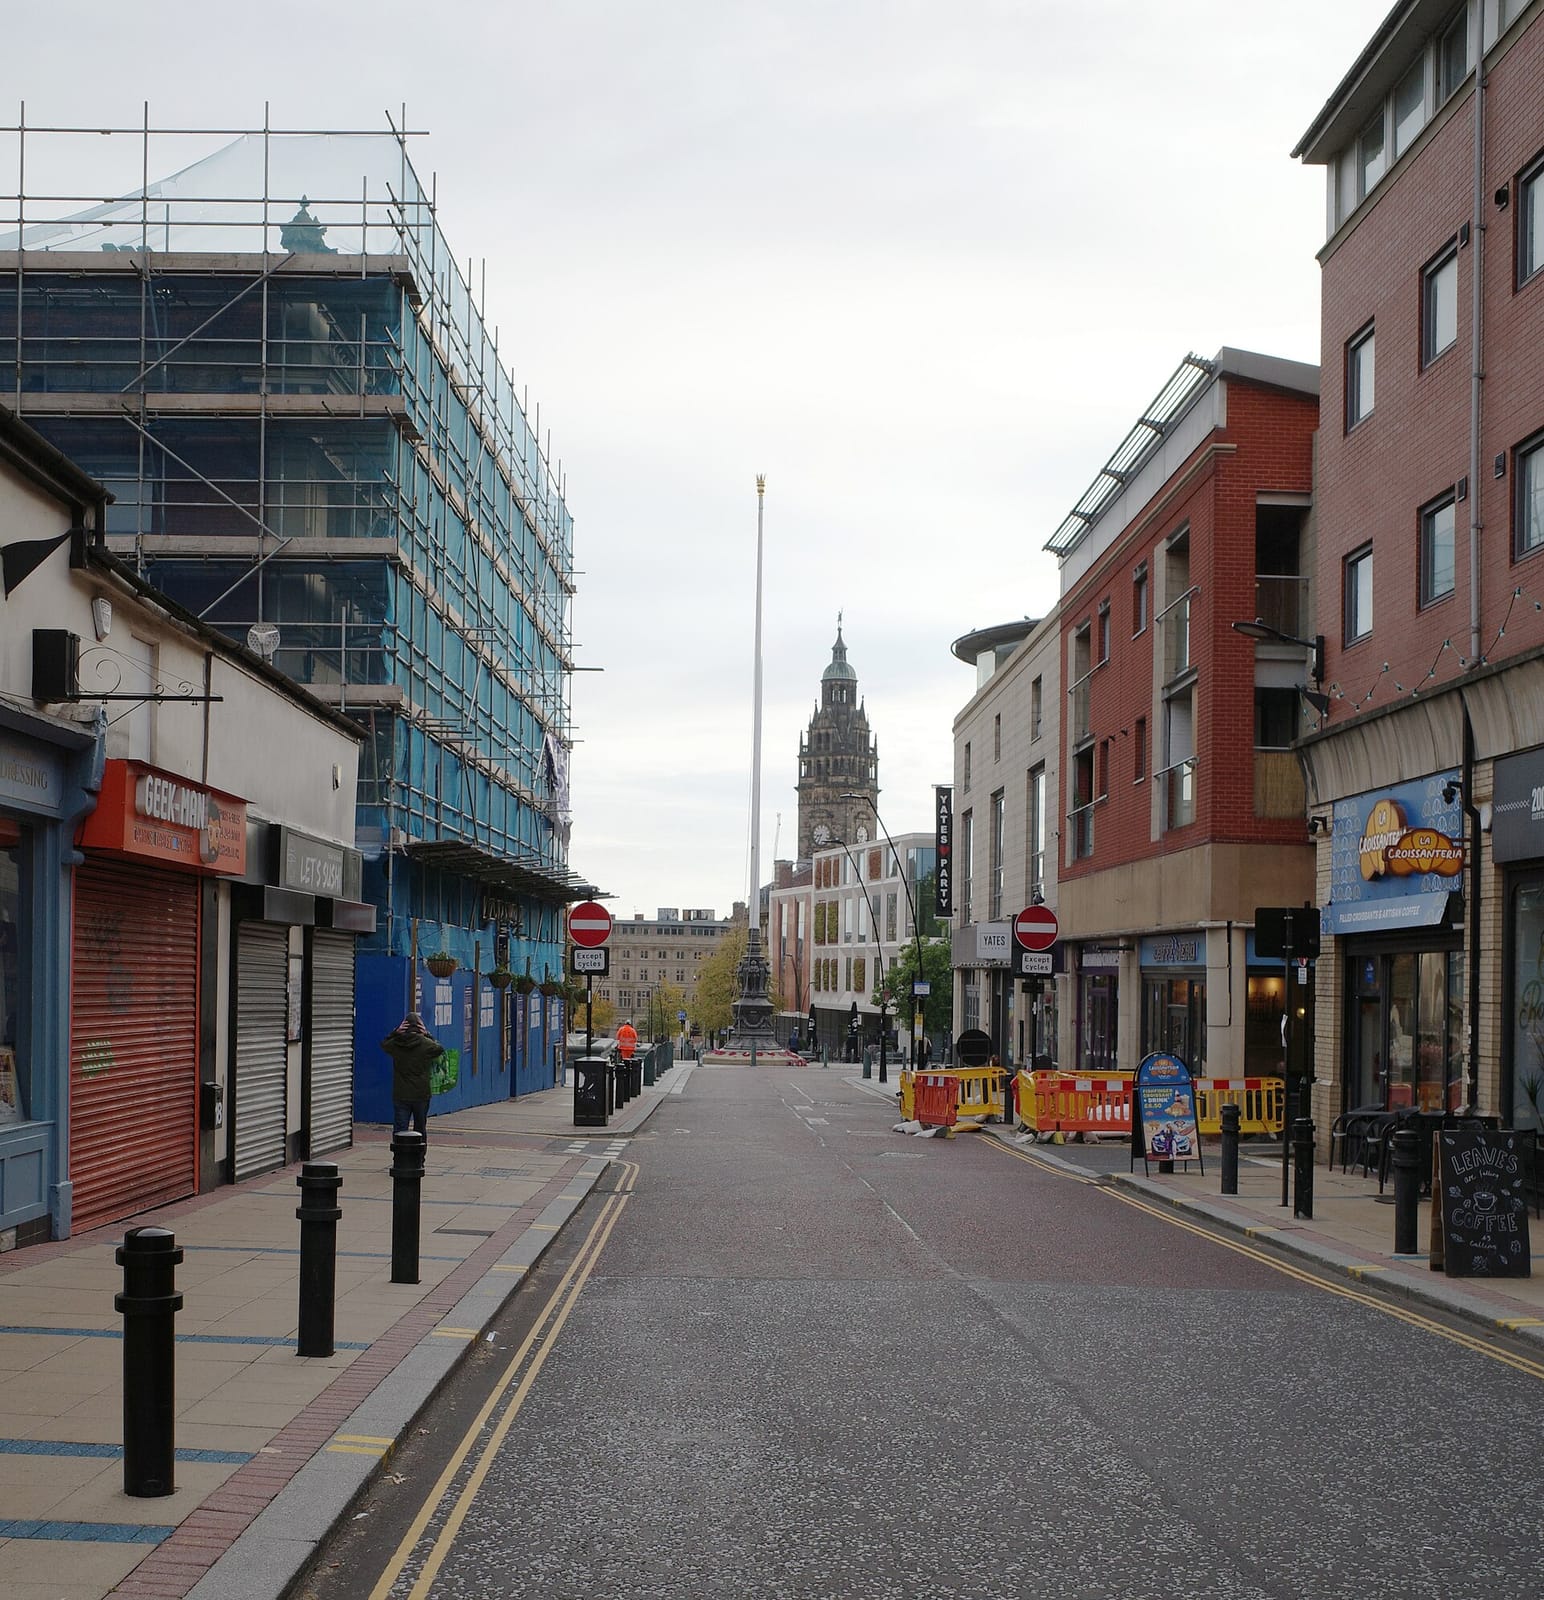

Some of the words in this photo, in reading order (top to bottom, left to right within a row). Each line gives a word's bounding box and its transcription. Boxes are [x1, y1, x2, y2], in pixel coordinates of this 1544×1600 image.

[145, 774, 206, 830] GEEK-MAN
[939, 795, 949, 844] YATES
[1379, 810, 1386, 826] LA
[1419, 836, 1431, 845] LA
[1388, 847, 1463, 859] CROISSANTERIA
[939, 859, 949, 908] PARTY
[983, 935, 1006, 946] YATES
[576, 952, 602, 961] Except
[1024, 955, 1050, 964] Except
[577, 961, 601, 969] cycles
[1025, 964, 1049, 972] cycles
[1451, 1146, 1519, 1175] LEAVES
[1452, 1208, 1518, 1232] COFFEE
